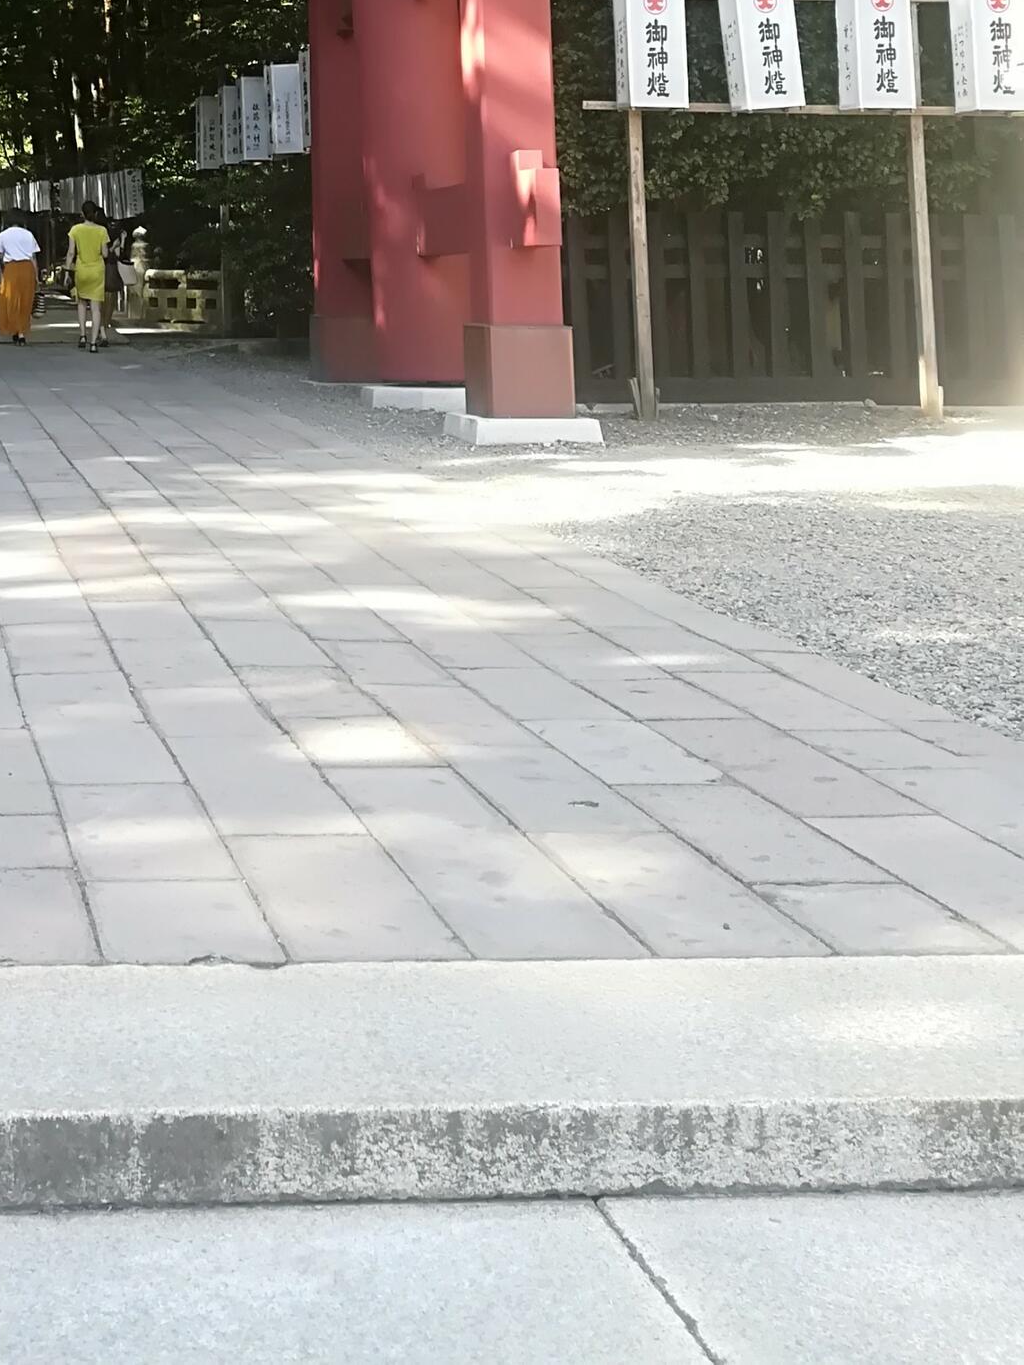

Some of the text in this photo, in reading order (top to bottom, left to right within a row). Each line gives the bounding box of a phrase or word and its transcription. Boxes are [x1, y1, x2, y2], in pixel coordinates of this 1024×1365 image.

[645, 19, 669, 97] 御神燈
[758, 18, 787, 95] 御神燈
[874, 16, 898, 93] 御神燈
